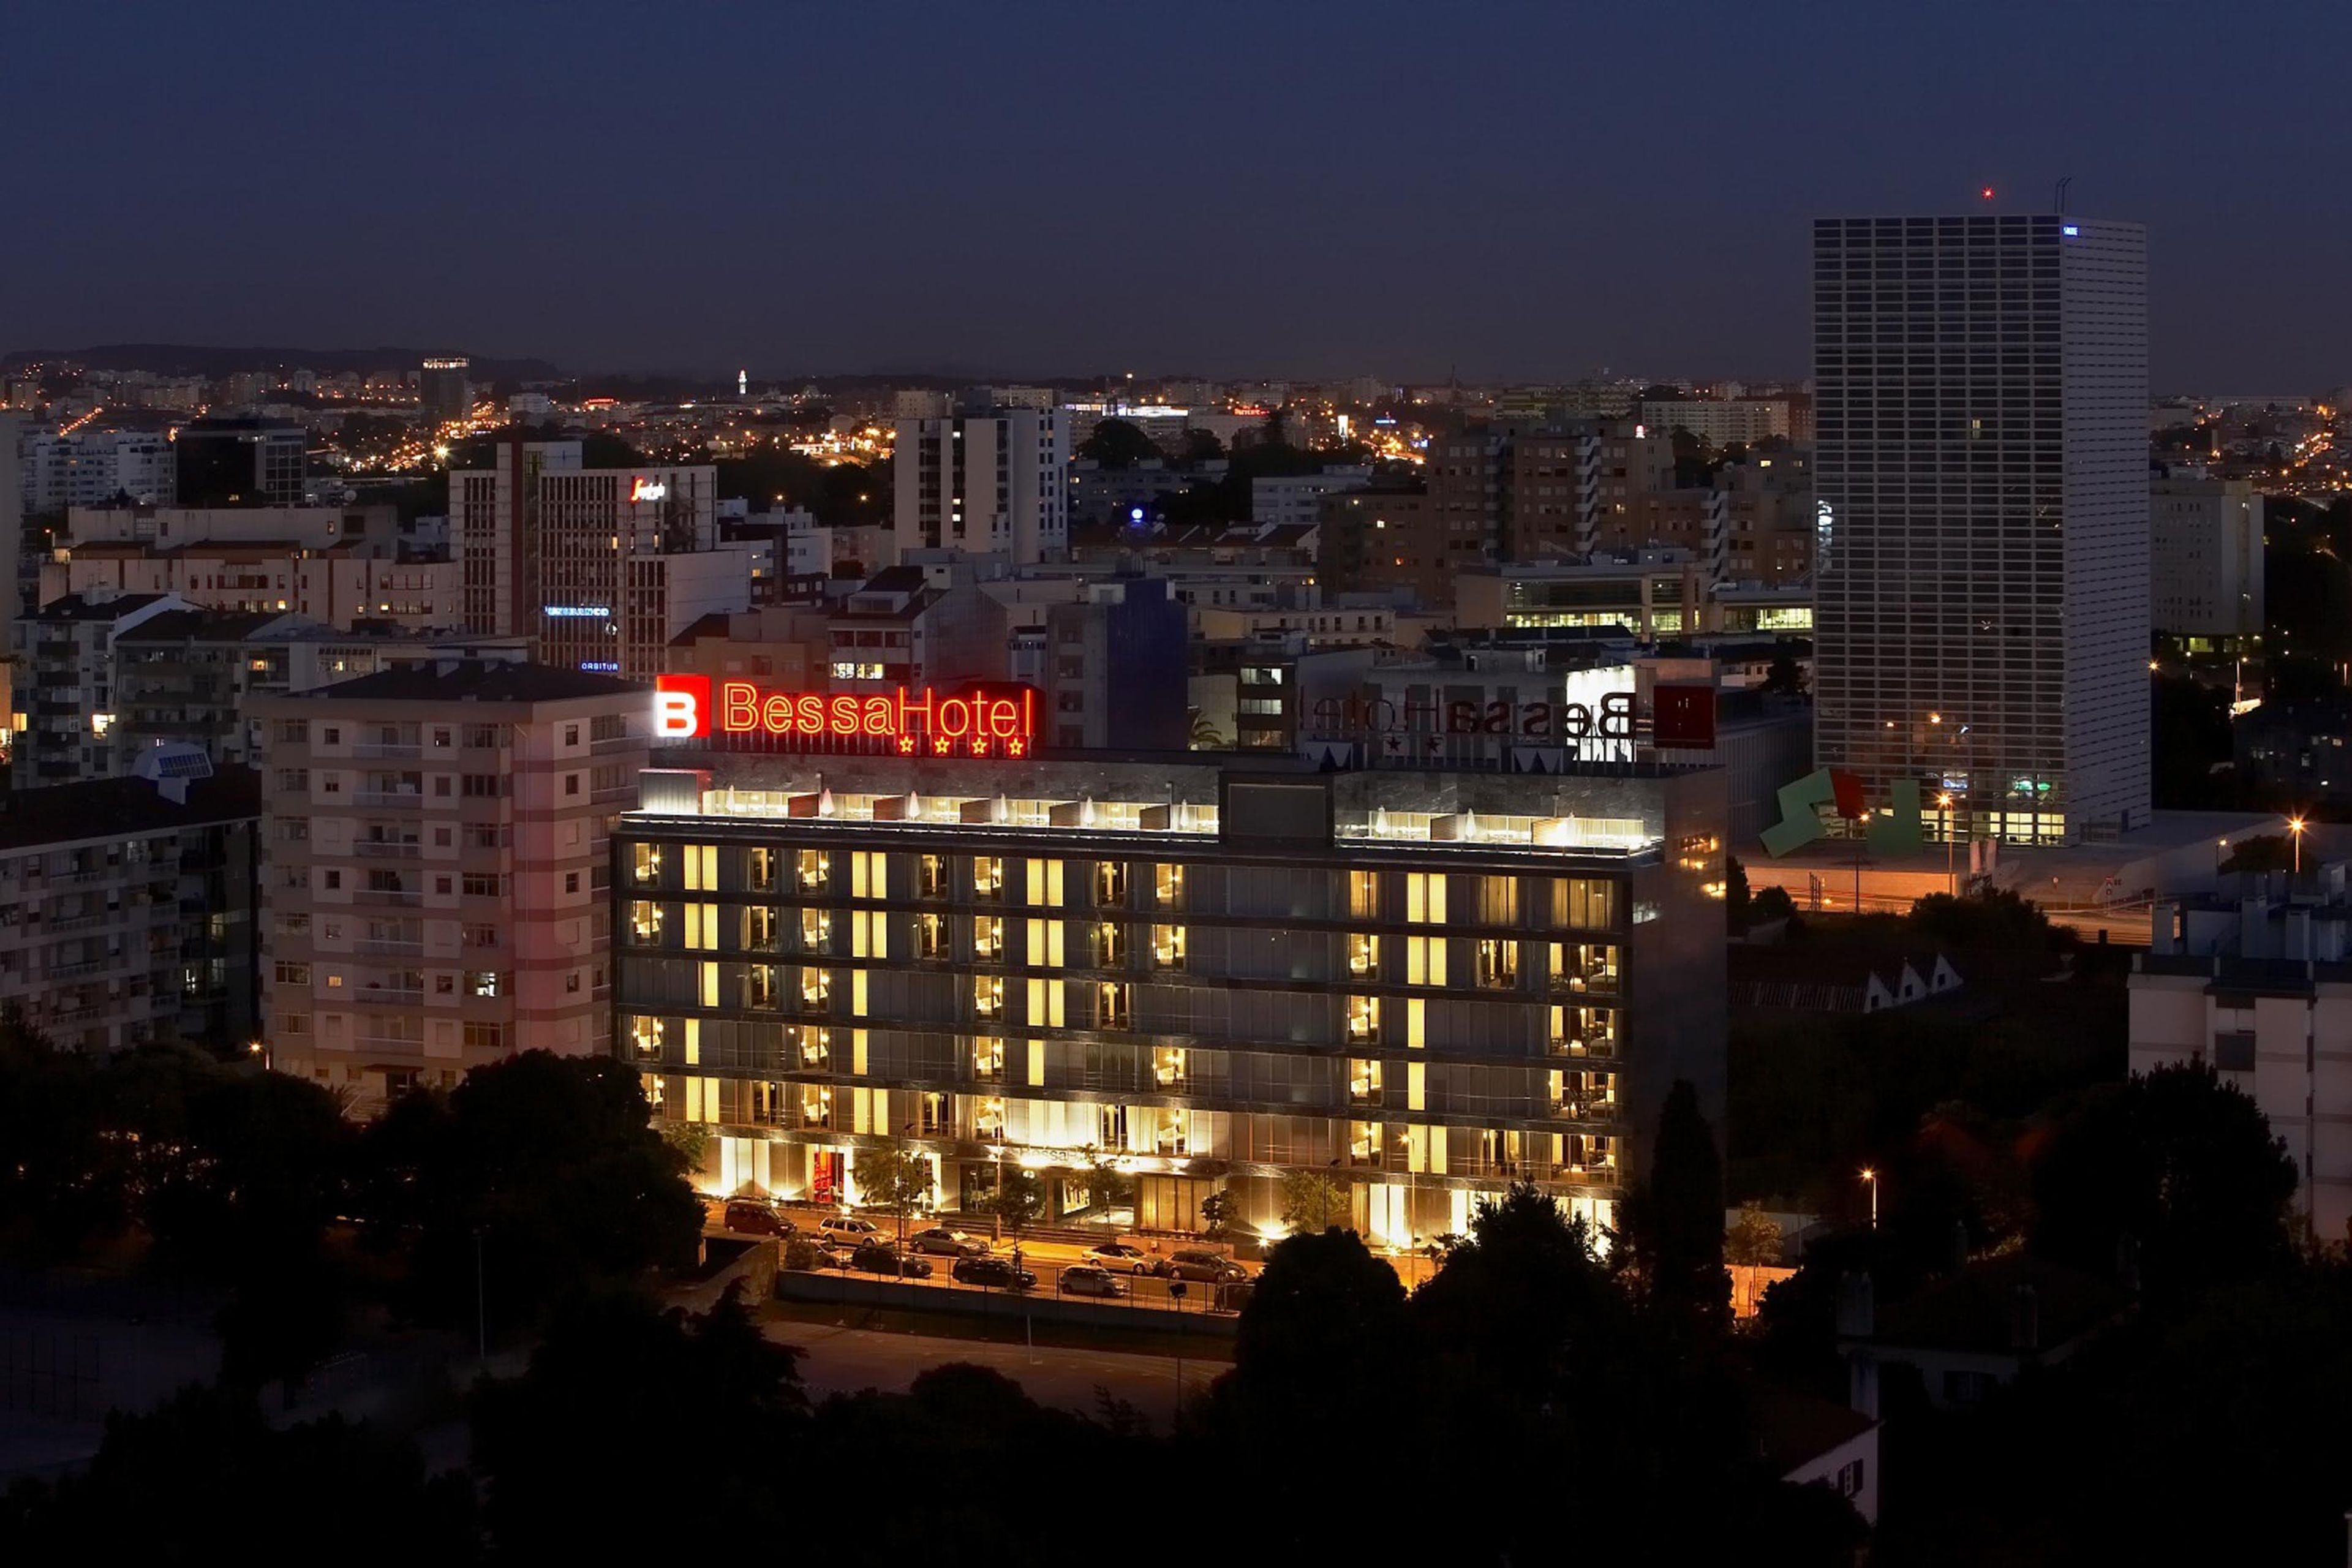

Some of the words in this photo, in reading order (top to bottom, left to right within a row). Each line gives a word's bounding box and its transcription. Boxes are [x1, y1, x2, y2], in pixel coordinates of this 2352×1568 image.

[581, 662, 619, 671] ORBITUR
[655, 691, 698, 737] B
[722, 682, 1031, 737] BessaHotel
